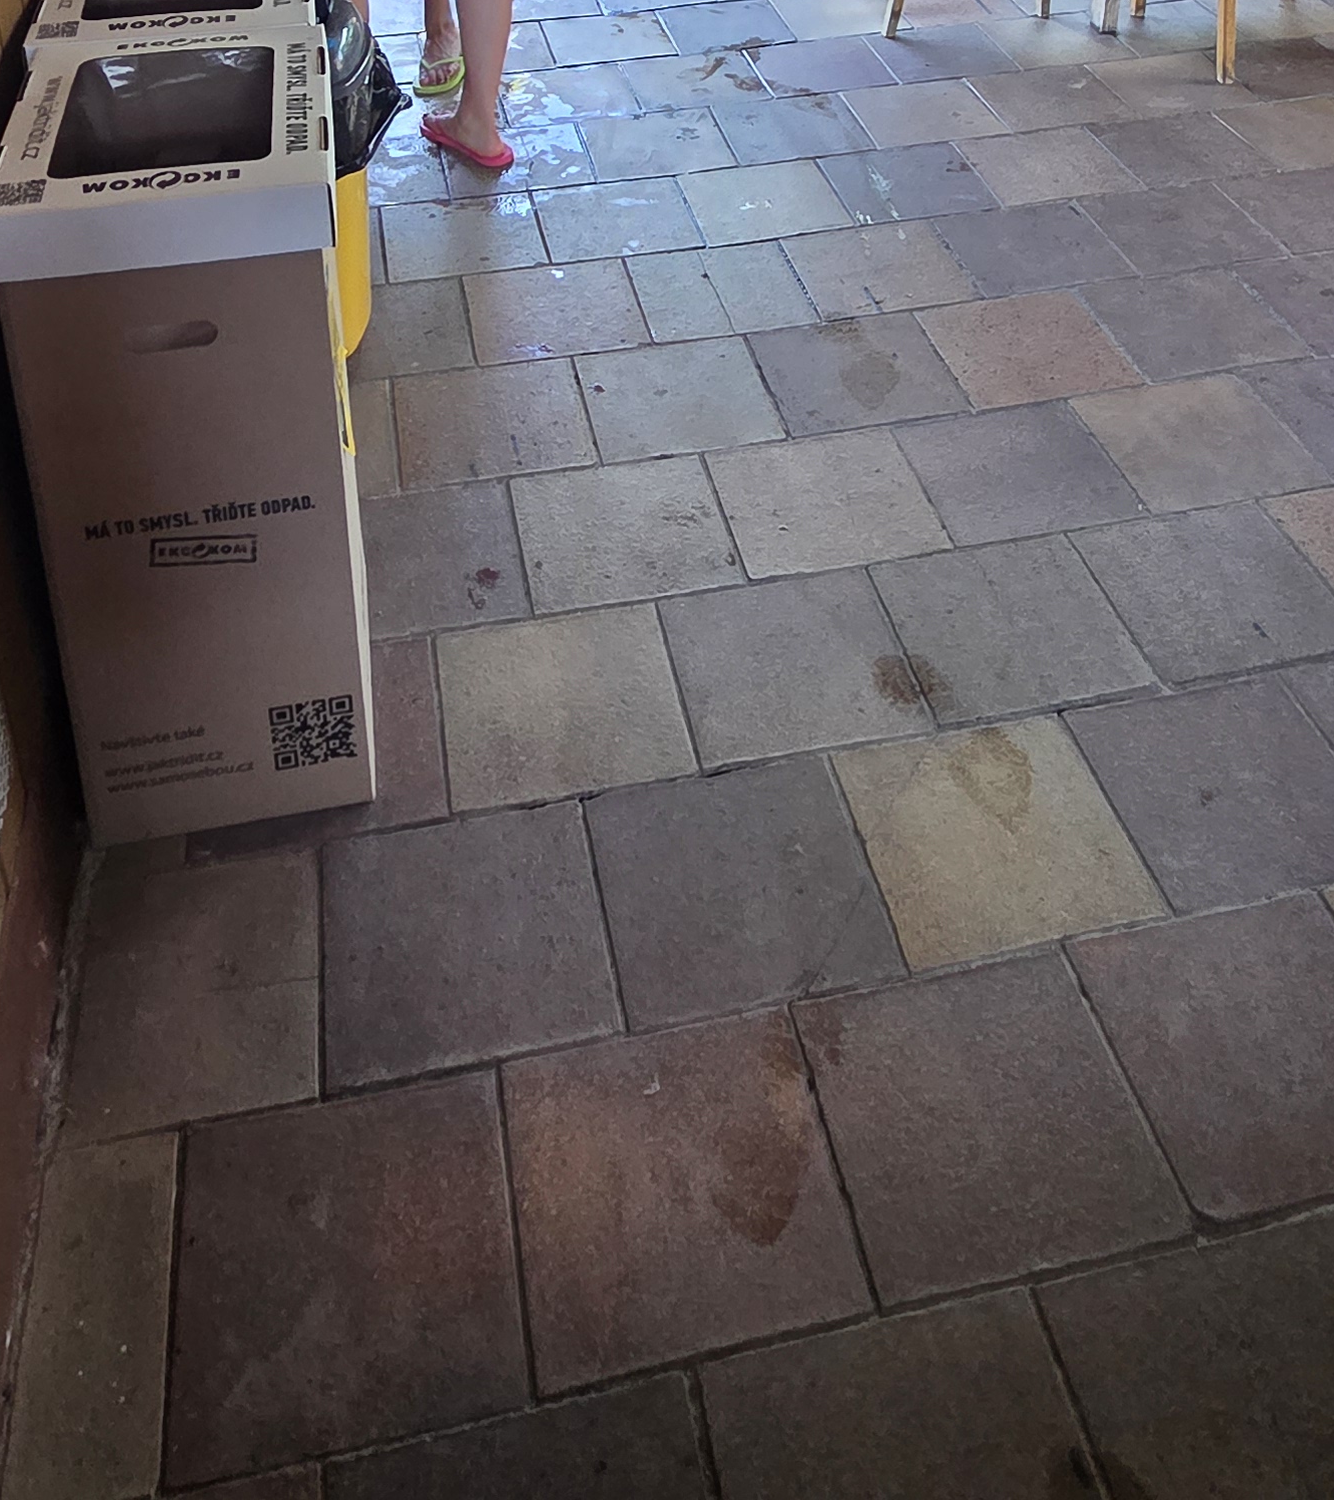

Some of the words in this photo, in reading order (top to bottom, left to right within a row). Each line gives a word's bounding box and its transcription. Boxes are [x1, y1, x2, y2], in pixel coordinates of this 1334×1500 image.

[84, 519, 111, 541] MÁ
[114, 520, 135, 535] TO
[139, 511, 199, 533] SMYSL.
[202, 501, 257, 524] TŘIĎTE
[261, 495, 316, 516] ODPAD.
